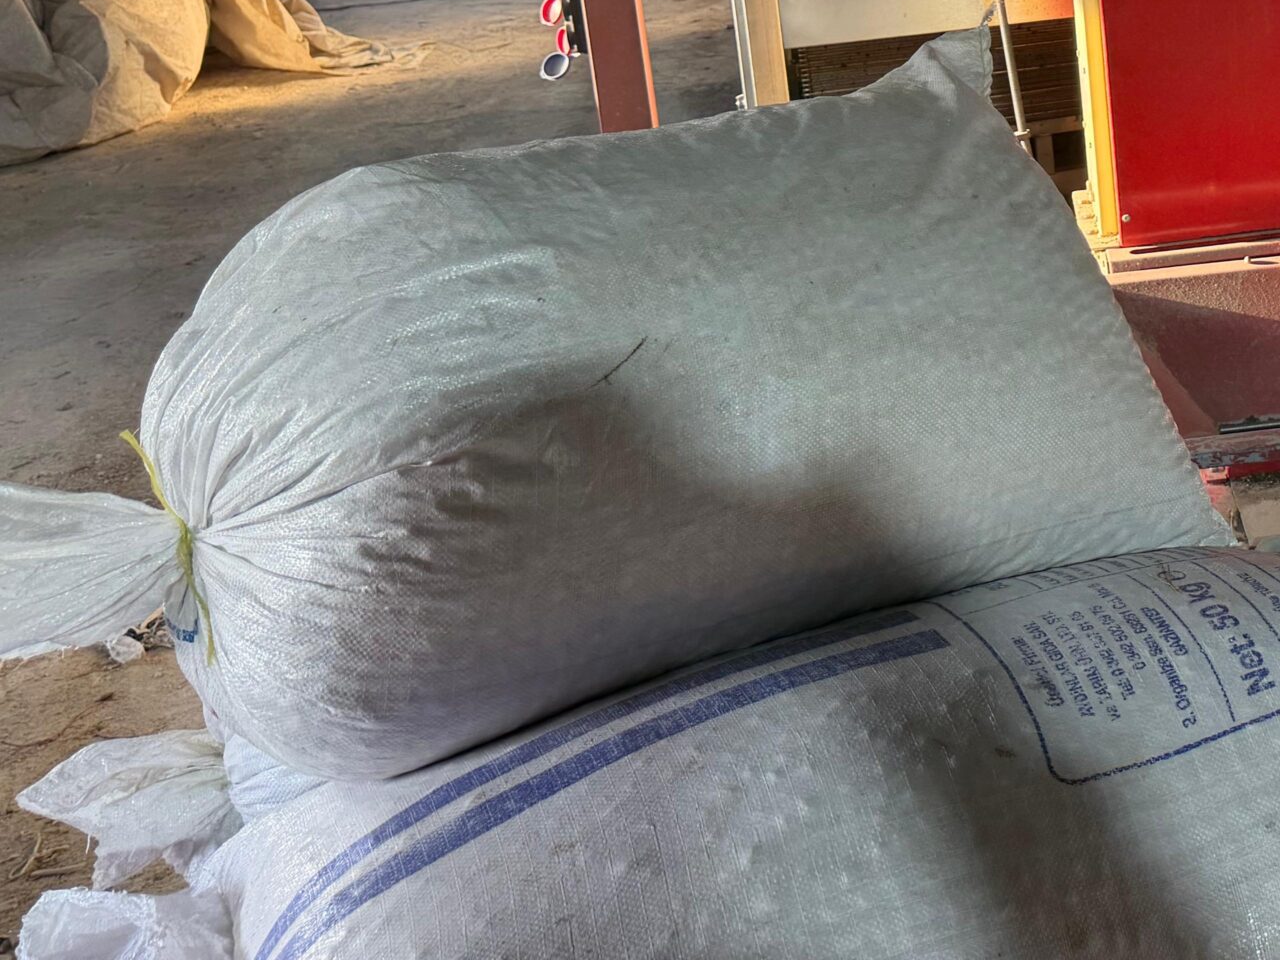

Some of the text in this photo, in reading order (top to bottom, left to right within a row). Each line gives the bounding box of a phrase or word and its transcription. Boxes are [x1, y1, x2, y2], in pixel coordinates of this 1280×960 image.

[1178, 582, 1214, 604] kg
[1199, 604, 1240, 631] 50
[1119, 642, 1139, 660] 342
[1132, 661, 1146, 670] 0
[1229, 633, 1276, 697] Net:
[1157, 656, 1191, 711] Organize
[1182, 711, 1198, 728] 2.
